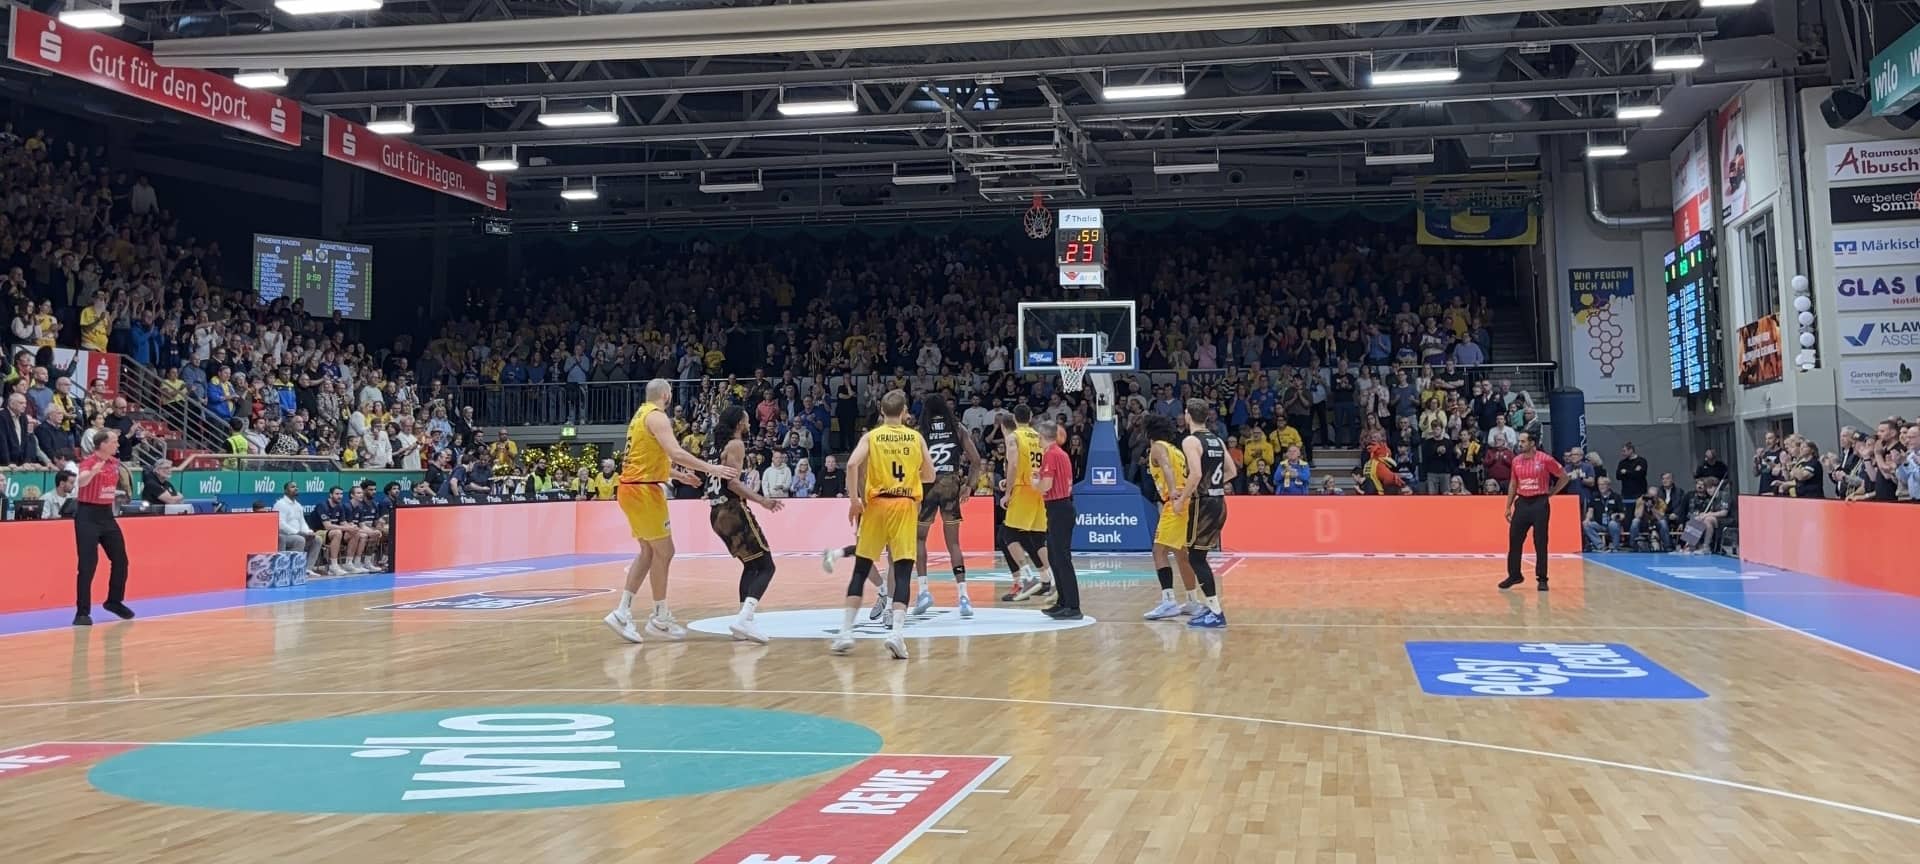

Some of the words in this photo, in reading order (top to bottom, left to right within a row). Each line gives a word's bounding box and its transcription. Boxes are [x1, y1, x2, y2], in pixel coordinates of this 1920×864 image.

[89, 45, 125, 81] Gut
[131, 56, 158, 90] für
[162, 67, 196, 103] den
[201, 81, 251, 120] Sport.
[1874, 59, 1898, 102] wilo
[1860, 147, 1920, 158] Raumauss
[382, 144, 404, 169] Gut
[407, 151, 425, 178] für
[427, 159, 466, 190] Hagen.
[1072, 215, 1098, 223] Thalia
[1066, 244, 1093, 262] 23
[1573, 271, 1591, 280] WIR
[1594, 270, 1629, 280] FEUERN
[1574, 281, 1597, 290] EUCH
[1838, 276, 1906, 297] GLAS
[1615, 384, 1636, 393] TTI
[876, 434, 916, 442] KRAUSHAAR
[892, 461, 905, 482] 4
[1211, 462, 1224, 485] 6
[200, 476, 222, 494] wilo
[255, 476, 276, 493] wilo
[306, 476, 325, 493] wilo
[1088, 530, 1122, 543] Bank
[350, 713, 625, 800] wilo
[819, 768, 950, 815] REWE
